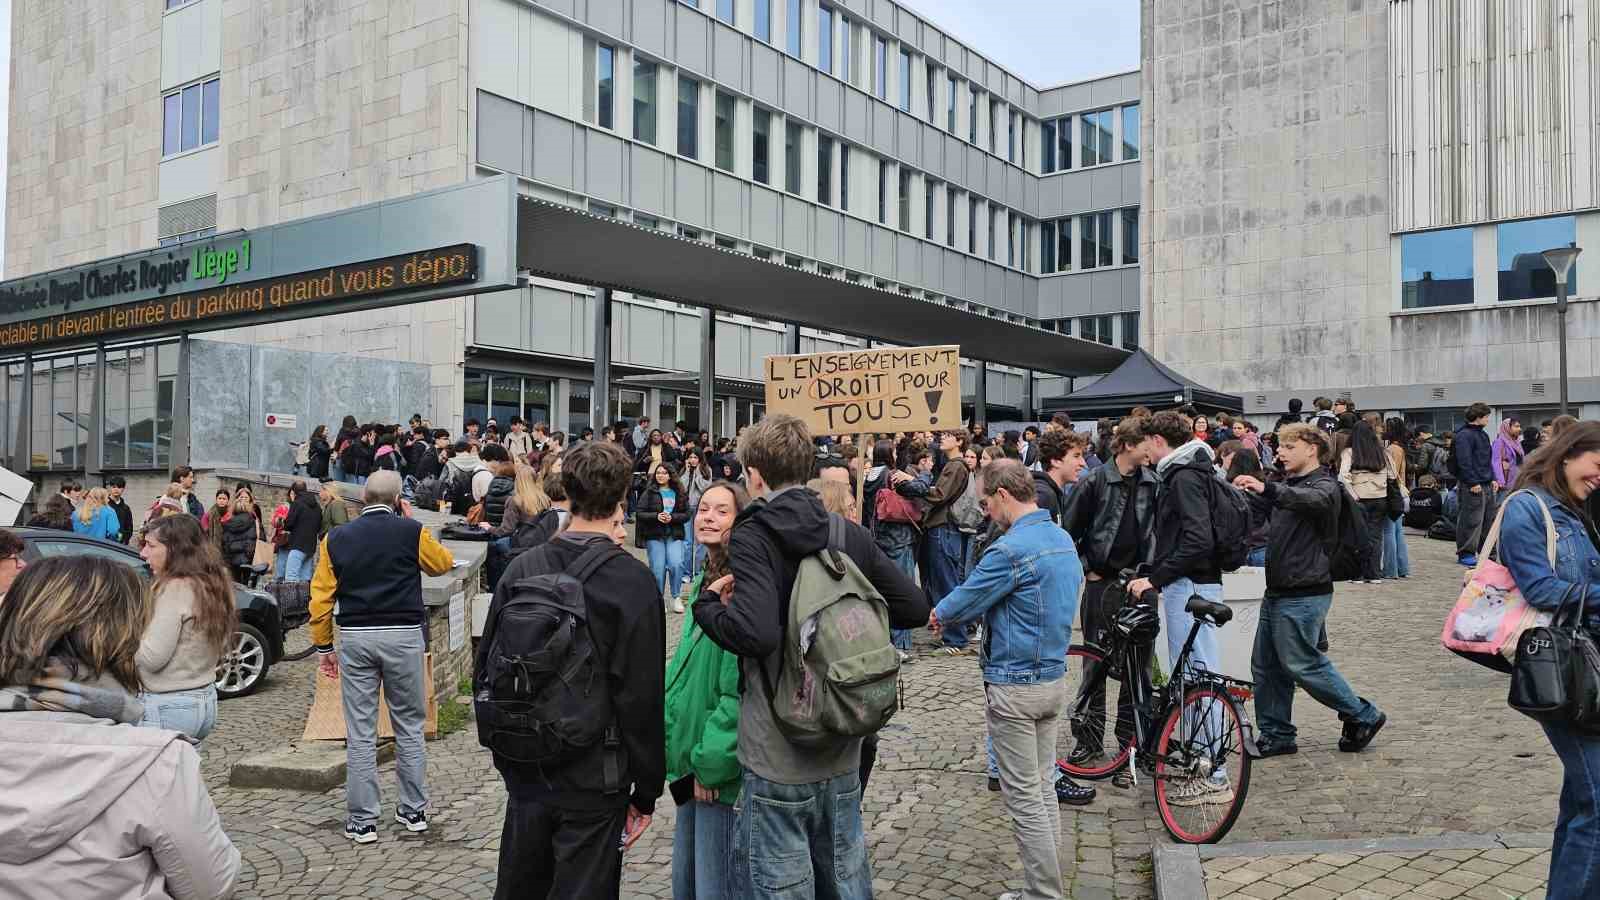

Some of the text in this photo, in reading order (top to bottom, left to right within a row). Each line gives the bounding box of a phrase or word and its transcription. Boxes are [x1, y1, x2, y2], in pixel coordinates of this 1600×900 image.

[49, 272, 84, 310] Royal
[86, 264, 136, 299] Charles
[139, 252, 189, 294] Rogier
[192, 243, 239, 284] Liège
[241, 239, 251, 272] 1
[41, 315, 54, 340] ni
[57, 312, 104, 338] devant
[109, 301, 165, 330] l'entrée
[170, 295, 192, 320] du
[196, 285, 264, 319] parking
[269, 267, 336, 307] quand
[340, 265, 395, 293] vous
[778, 386, 802, 400] UN
[897, 370, 952, 392] POUR
[813, 396, 912, 430] TOUS
